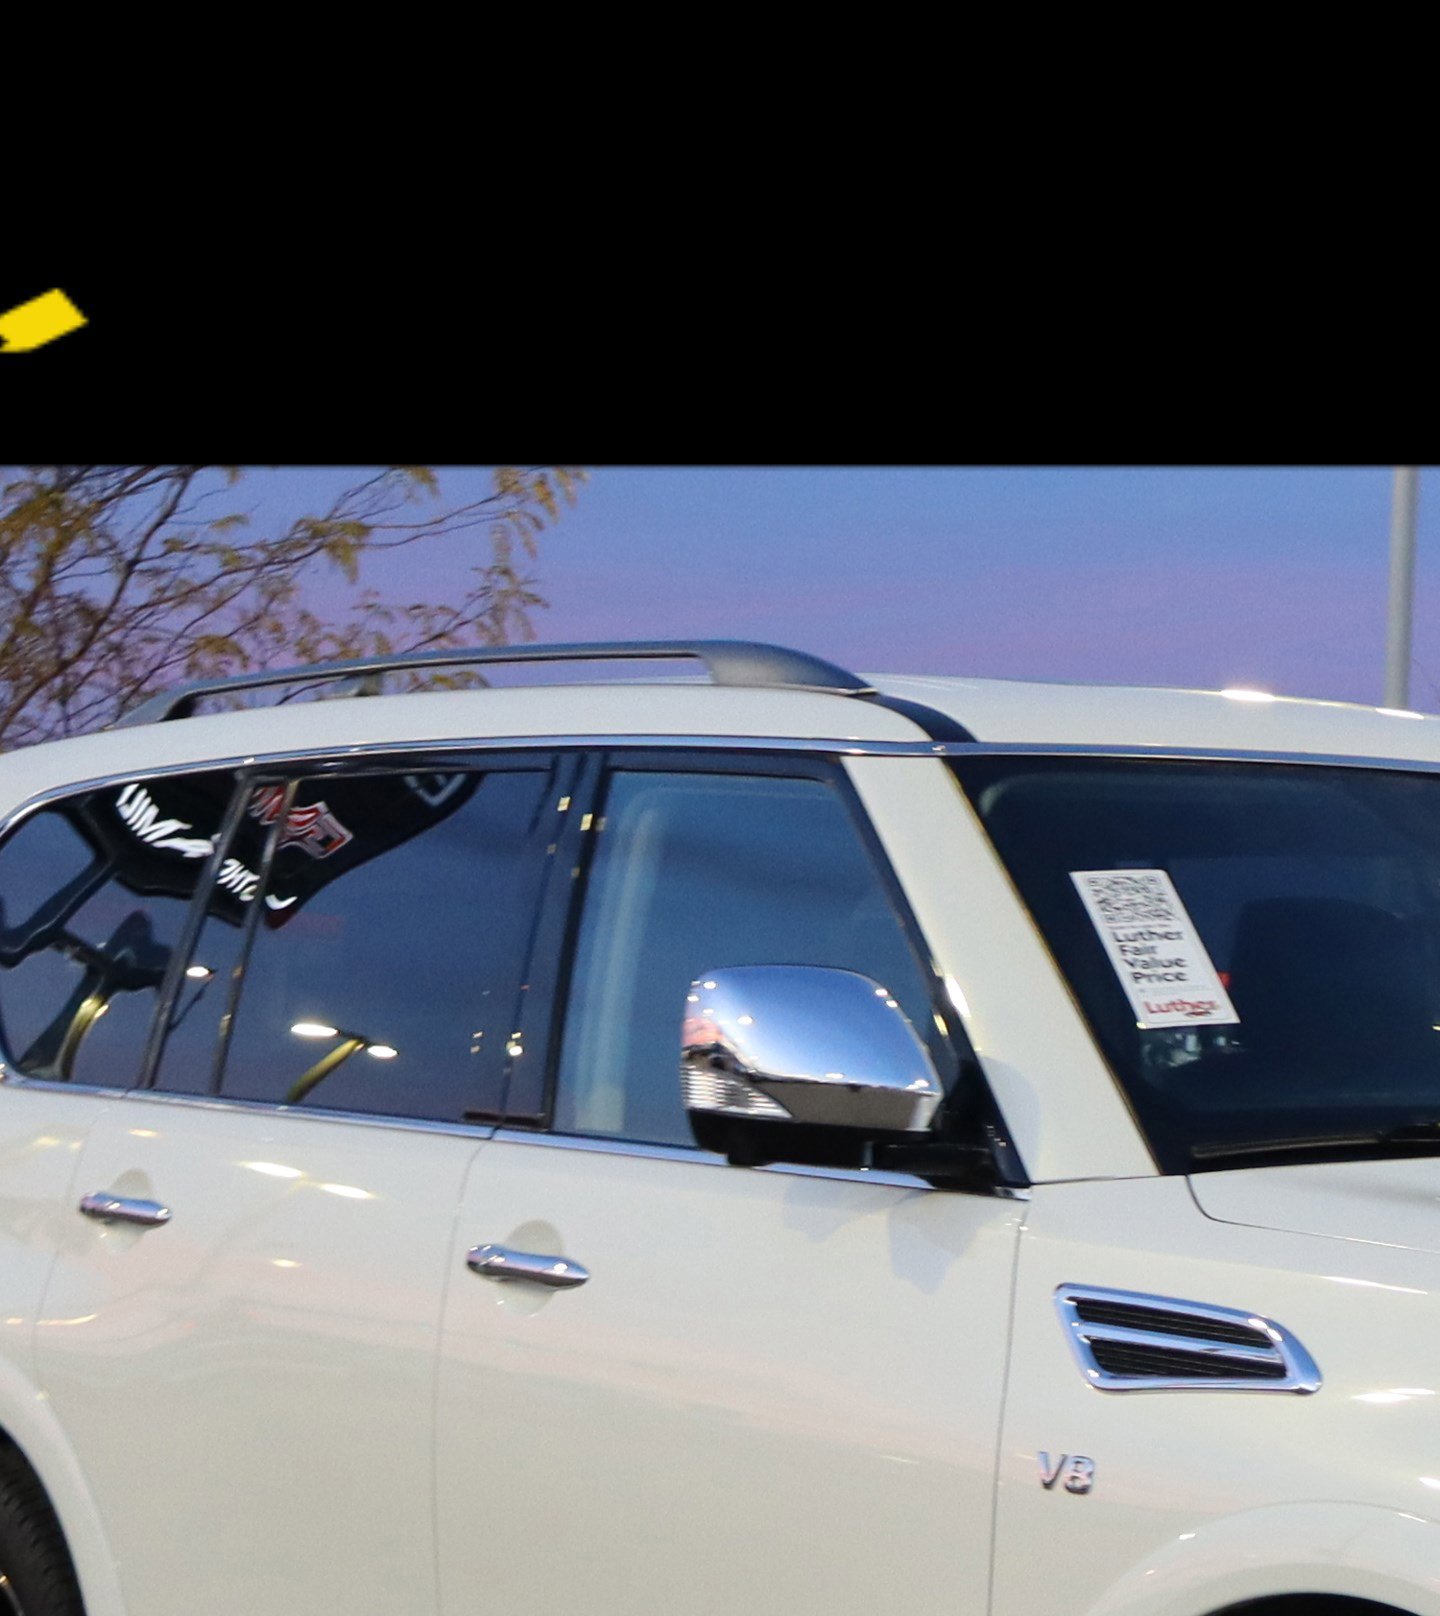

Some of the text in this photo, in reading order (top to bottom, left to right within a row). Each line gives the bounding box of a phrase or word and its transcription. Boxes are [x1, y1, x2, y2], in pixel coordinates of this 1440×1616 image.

[1112, 930, 1184, 943] Luther
[1119, 944, 1158, 956] Fair
[1123, 957, 1188, 969] Value
[1131, 971, 1188, 984] Price
[1143, 999, 1219, 1014] Luther
[1036, 1450, 1096, 1495] V8
